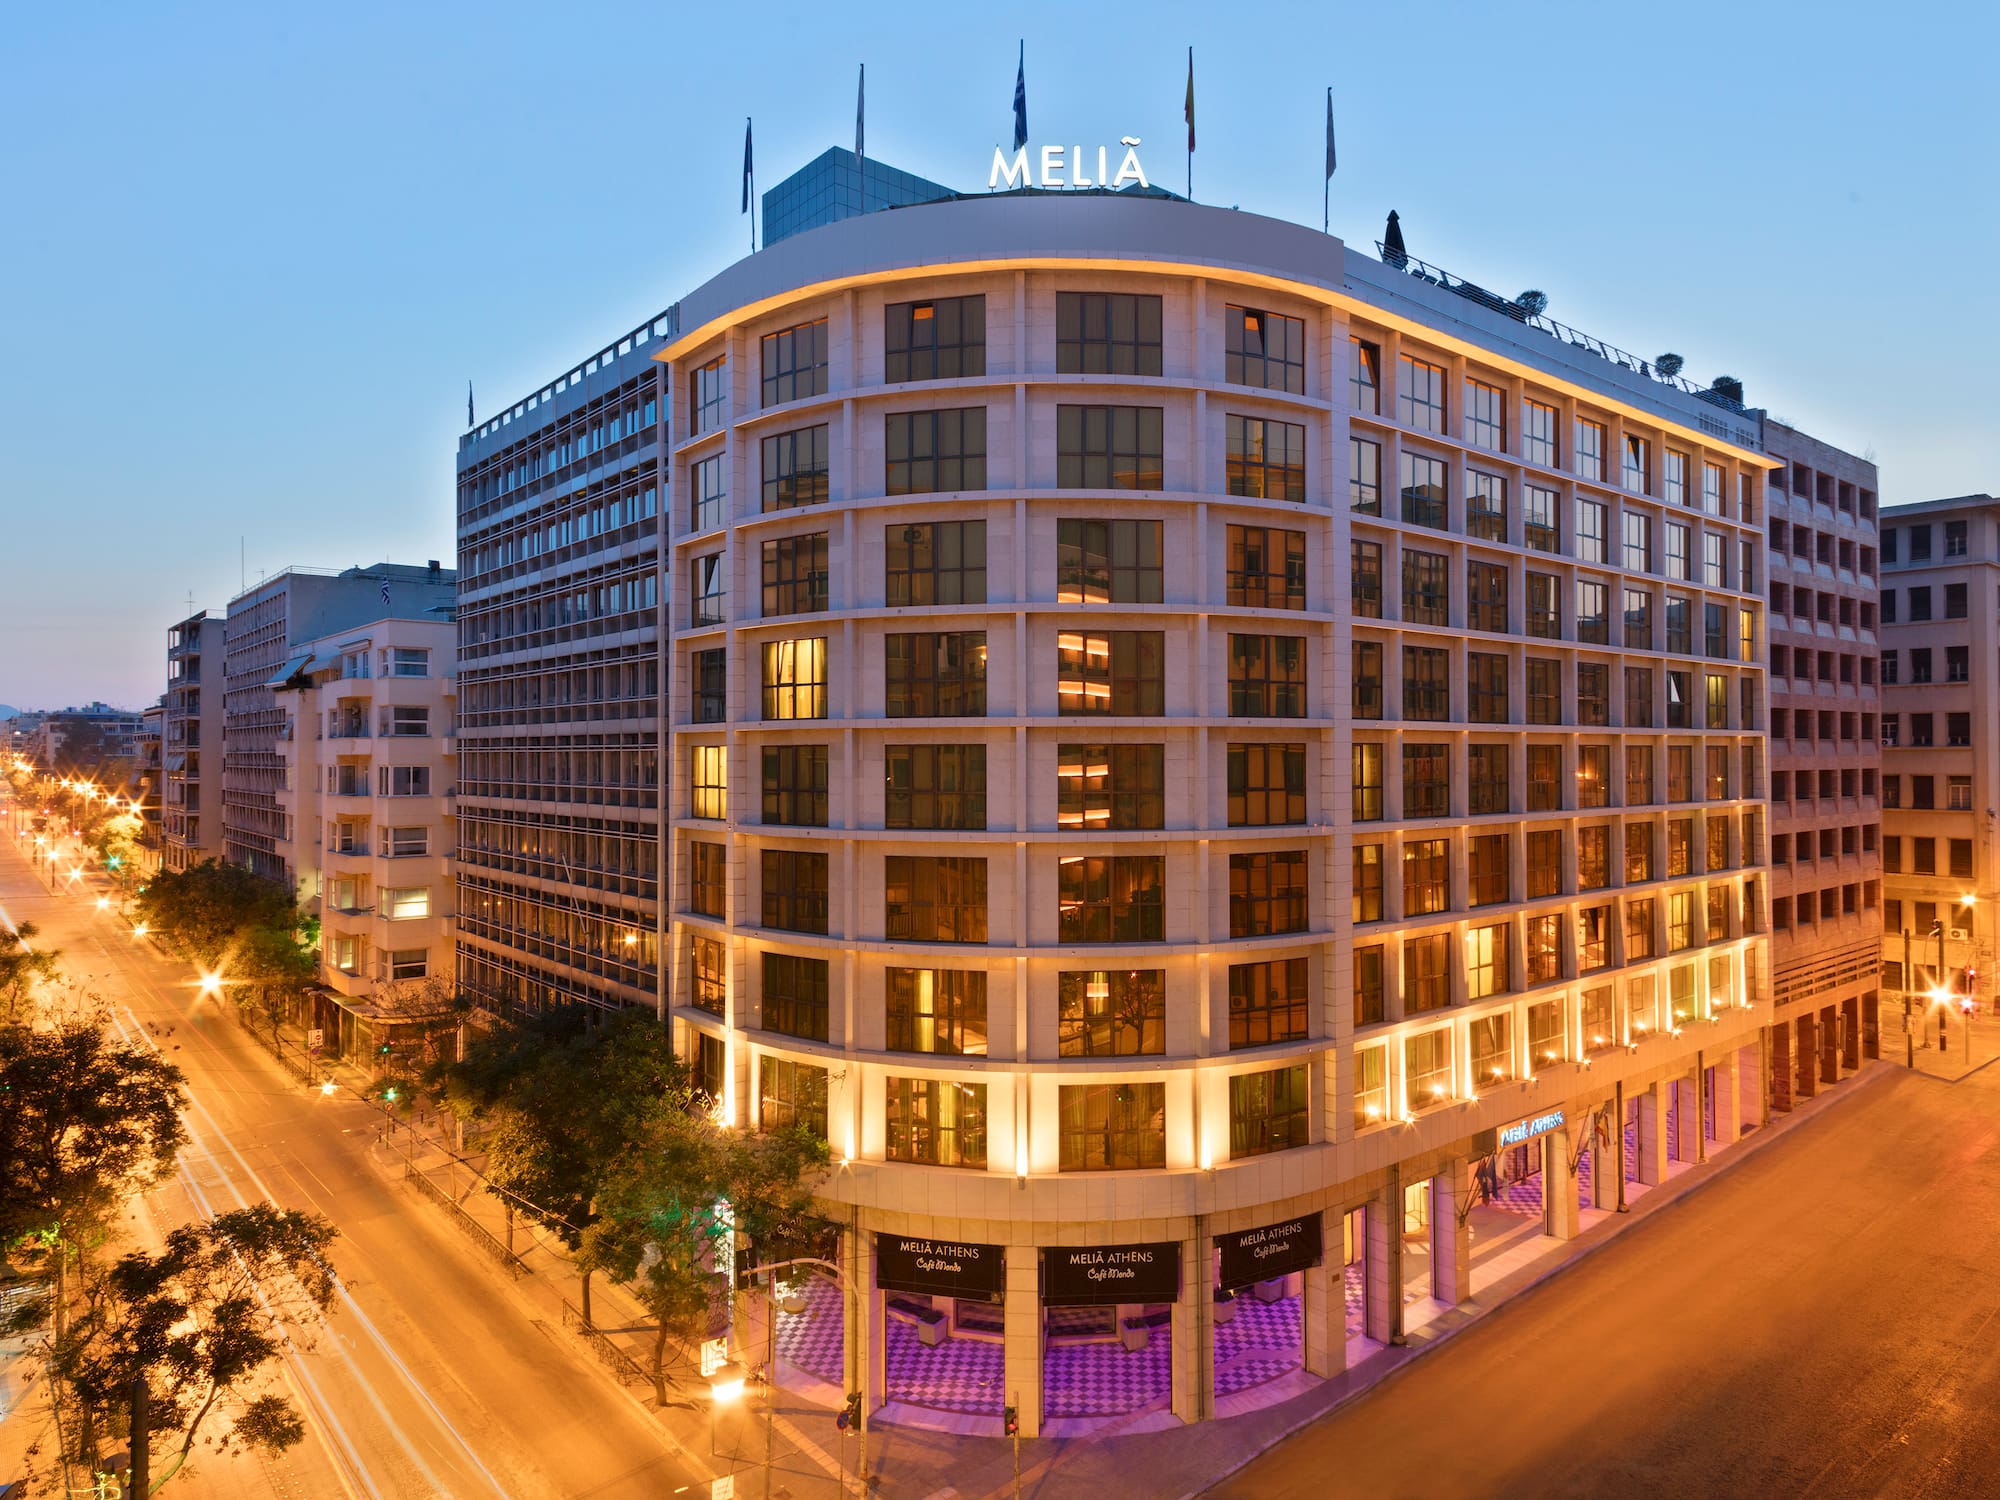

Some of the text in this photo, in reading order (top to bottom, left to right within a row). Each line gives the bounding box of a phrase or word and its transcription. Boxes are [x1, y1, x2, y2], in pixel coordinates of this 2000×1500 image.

[1268, 1222, 1303, 1241] ATHENS
[935, 1245, 980, 1259] ATHENS
[1107, 1251, 1154, 1264] ATHENS
[916, 1257, 935, 1272] Café
[1087, 1267, 1107, 1282] Café
